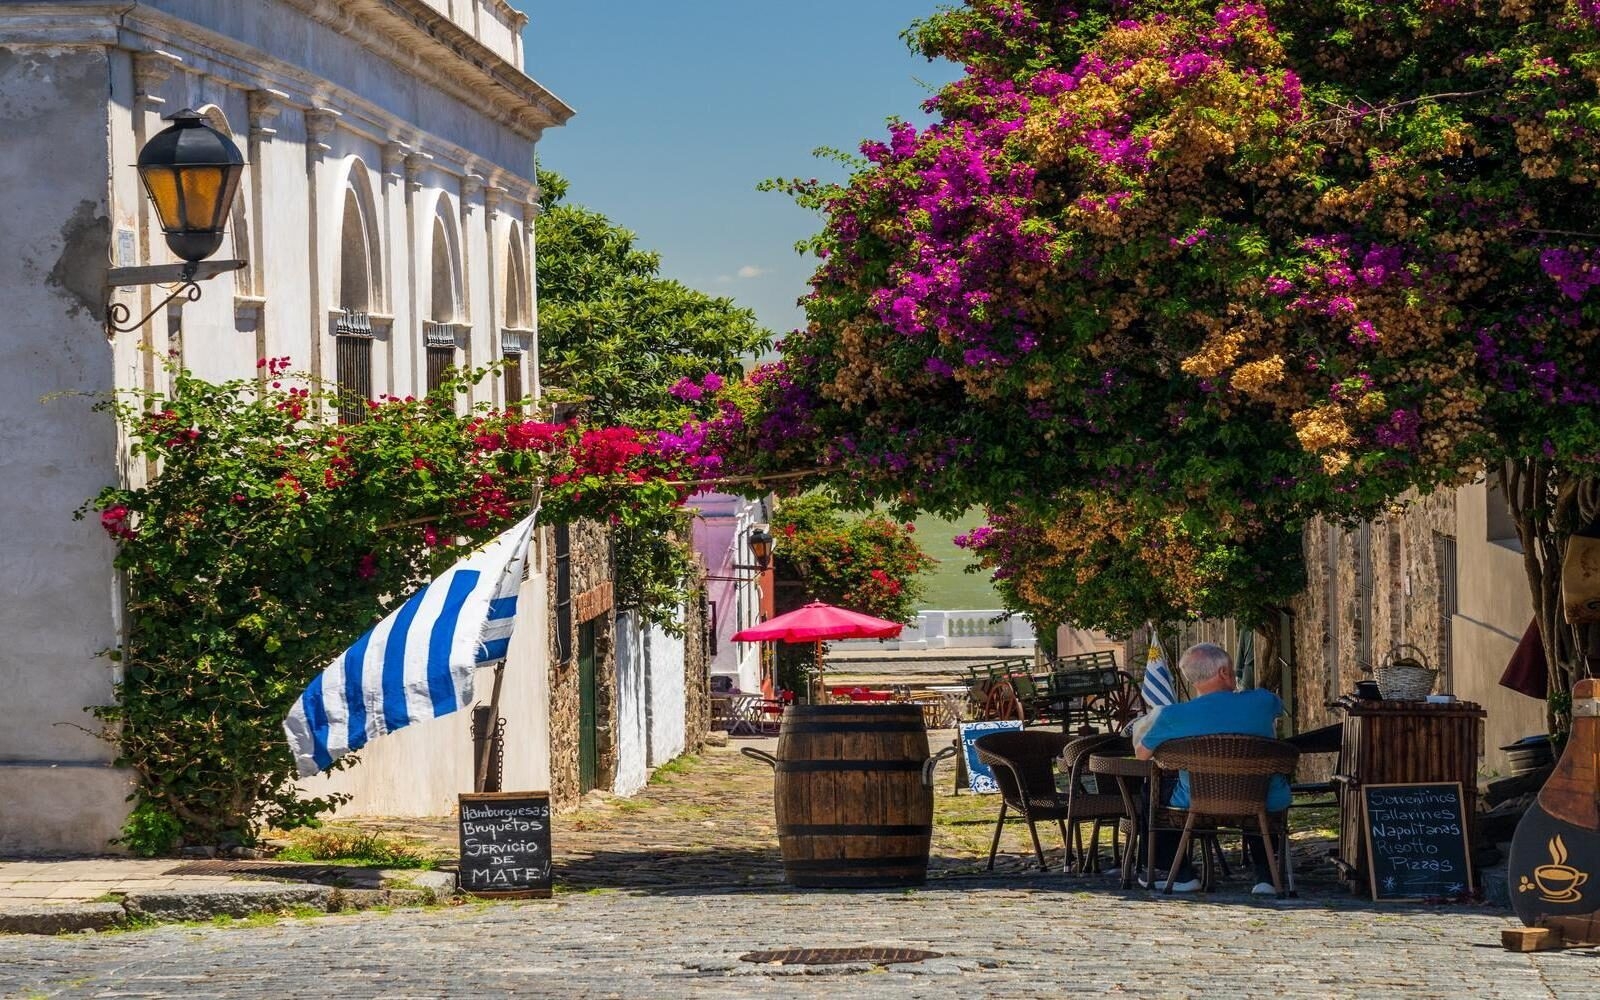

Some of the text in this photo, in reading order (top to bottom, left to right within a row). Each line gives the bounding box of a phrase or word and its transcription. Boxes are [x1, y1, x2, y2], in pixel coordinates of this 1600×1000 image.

[1369, 808, 1455, 821] Tallarines
[1373, 823, 1460, 840] Napolitanas
[1377, 839, 1438, 855] Risotto
[490, 855, 516, 865] DE
[1388, 856, 1453, 872] Pizzas
